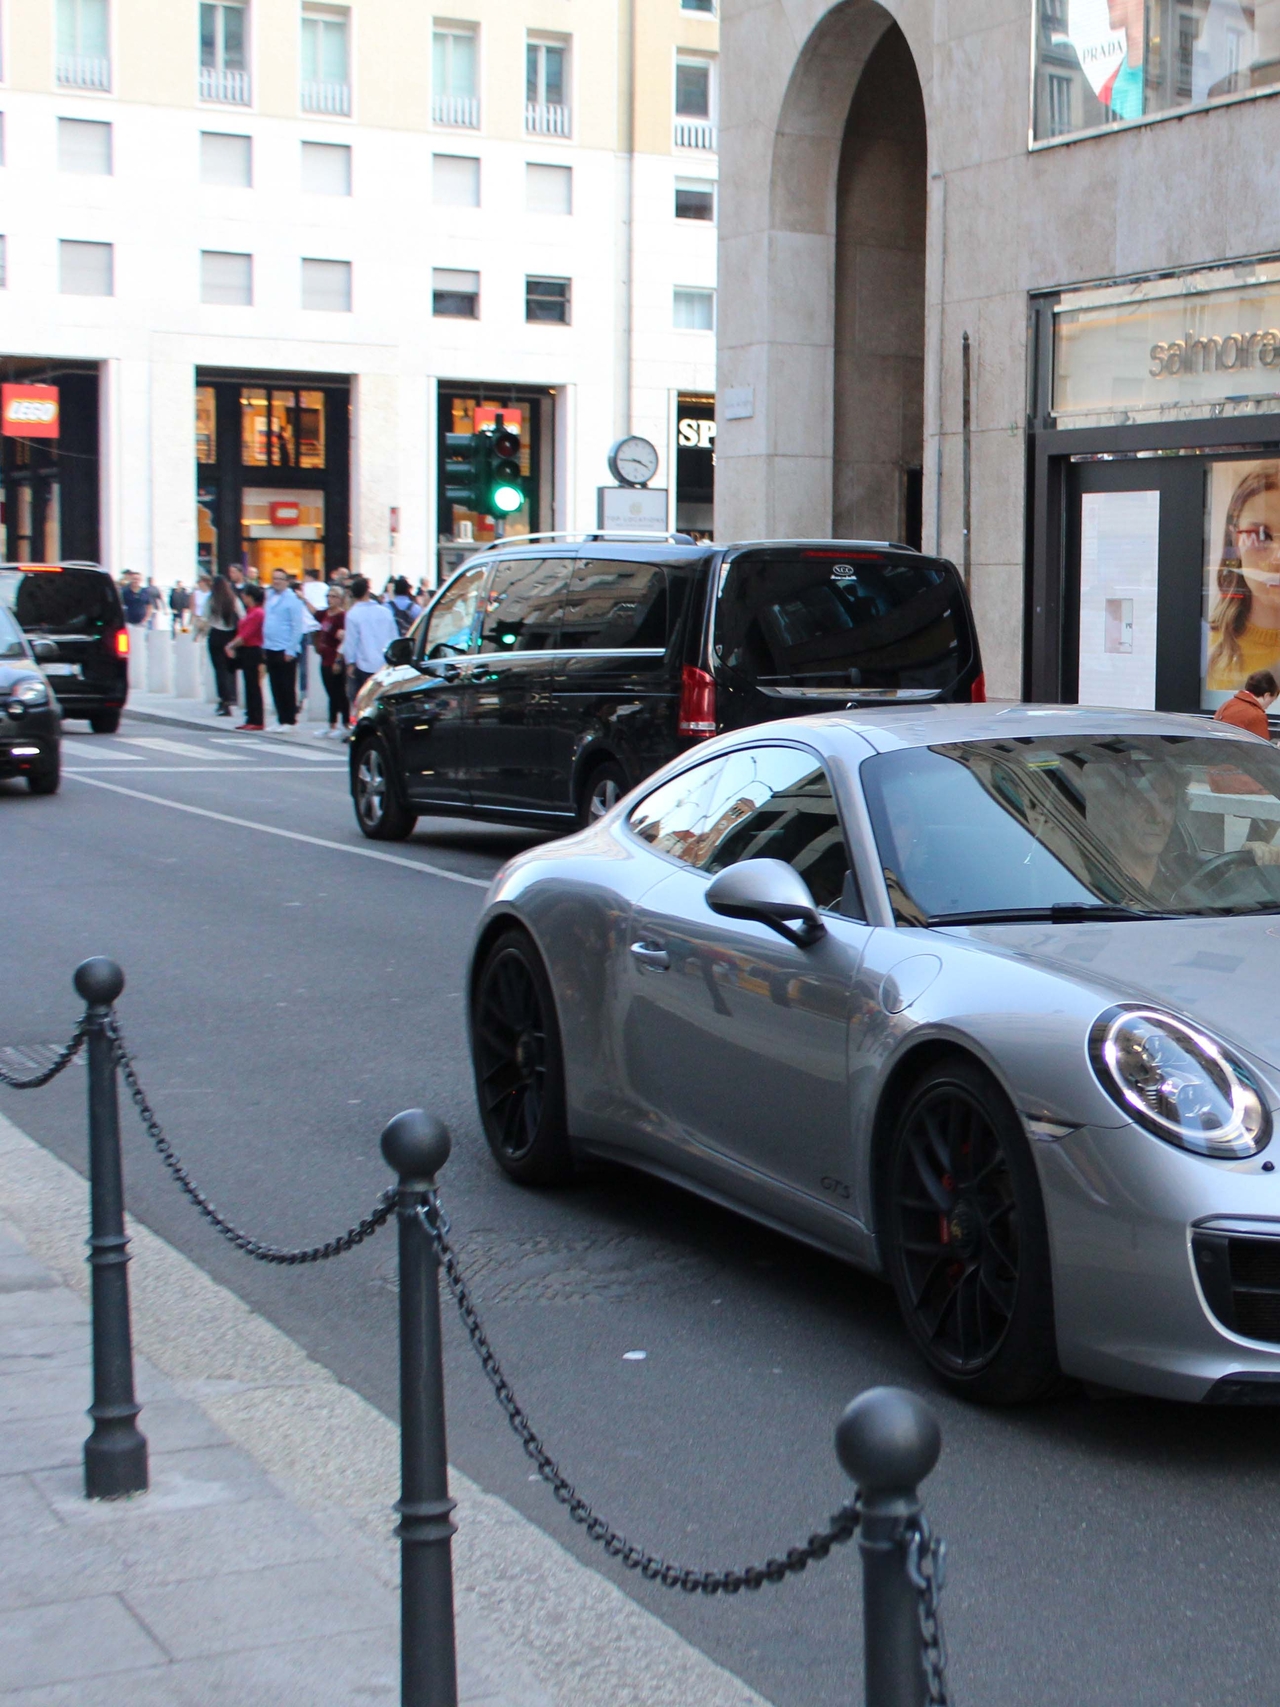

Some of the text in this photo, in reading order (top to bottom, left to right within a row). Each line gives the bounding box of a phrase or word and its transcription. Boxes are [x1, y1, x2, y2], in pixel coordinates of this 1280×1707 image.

[1082, 40, 1123, 63] PRADA
[8, 400, 57, 422] LEGO
[821, 1176, 851, 1199] GTS
